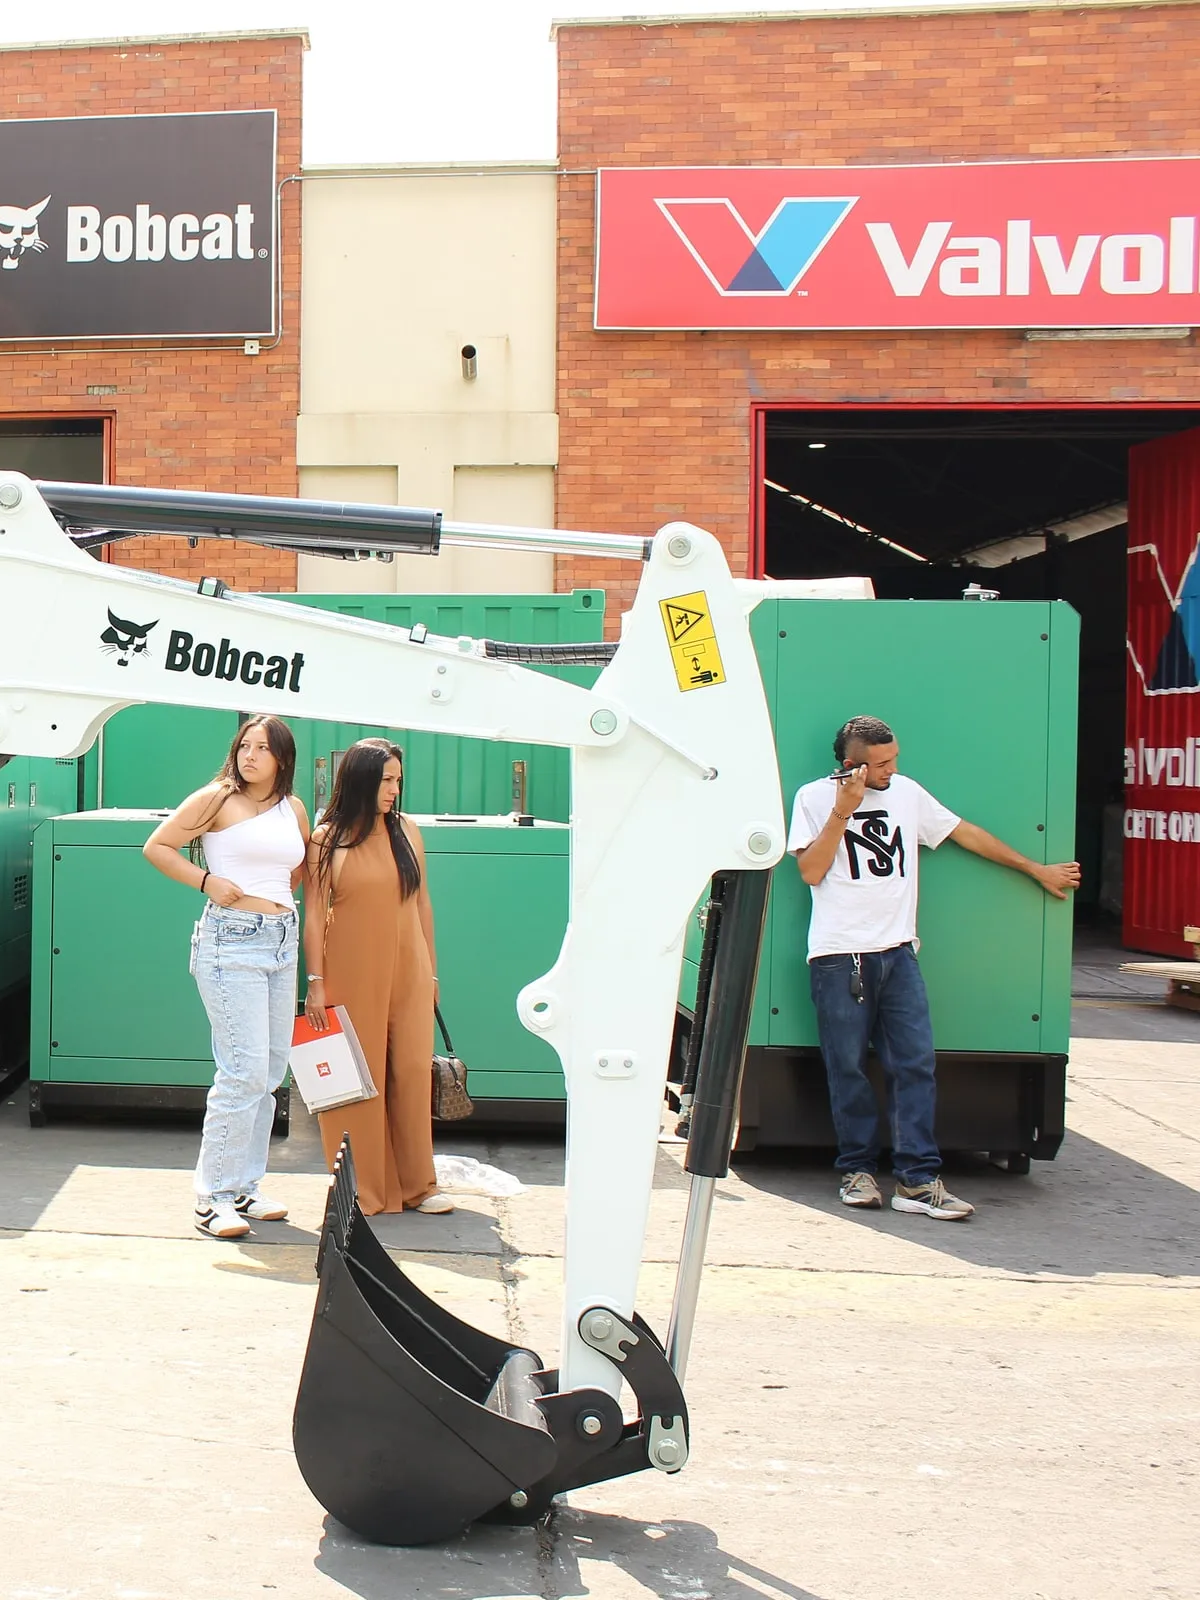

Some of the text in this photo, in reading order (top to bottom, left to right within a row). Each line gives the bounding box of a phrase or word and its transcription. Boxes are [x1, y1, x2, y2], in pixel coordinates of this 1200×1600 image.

[66, 204, 254, 263] Bobcat
[865, 215, 1200, 297] Valvol
[165, 630, 305, 692] Bobcat
